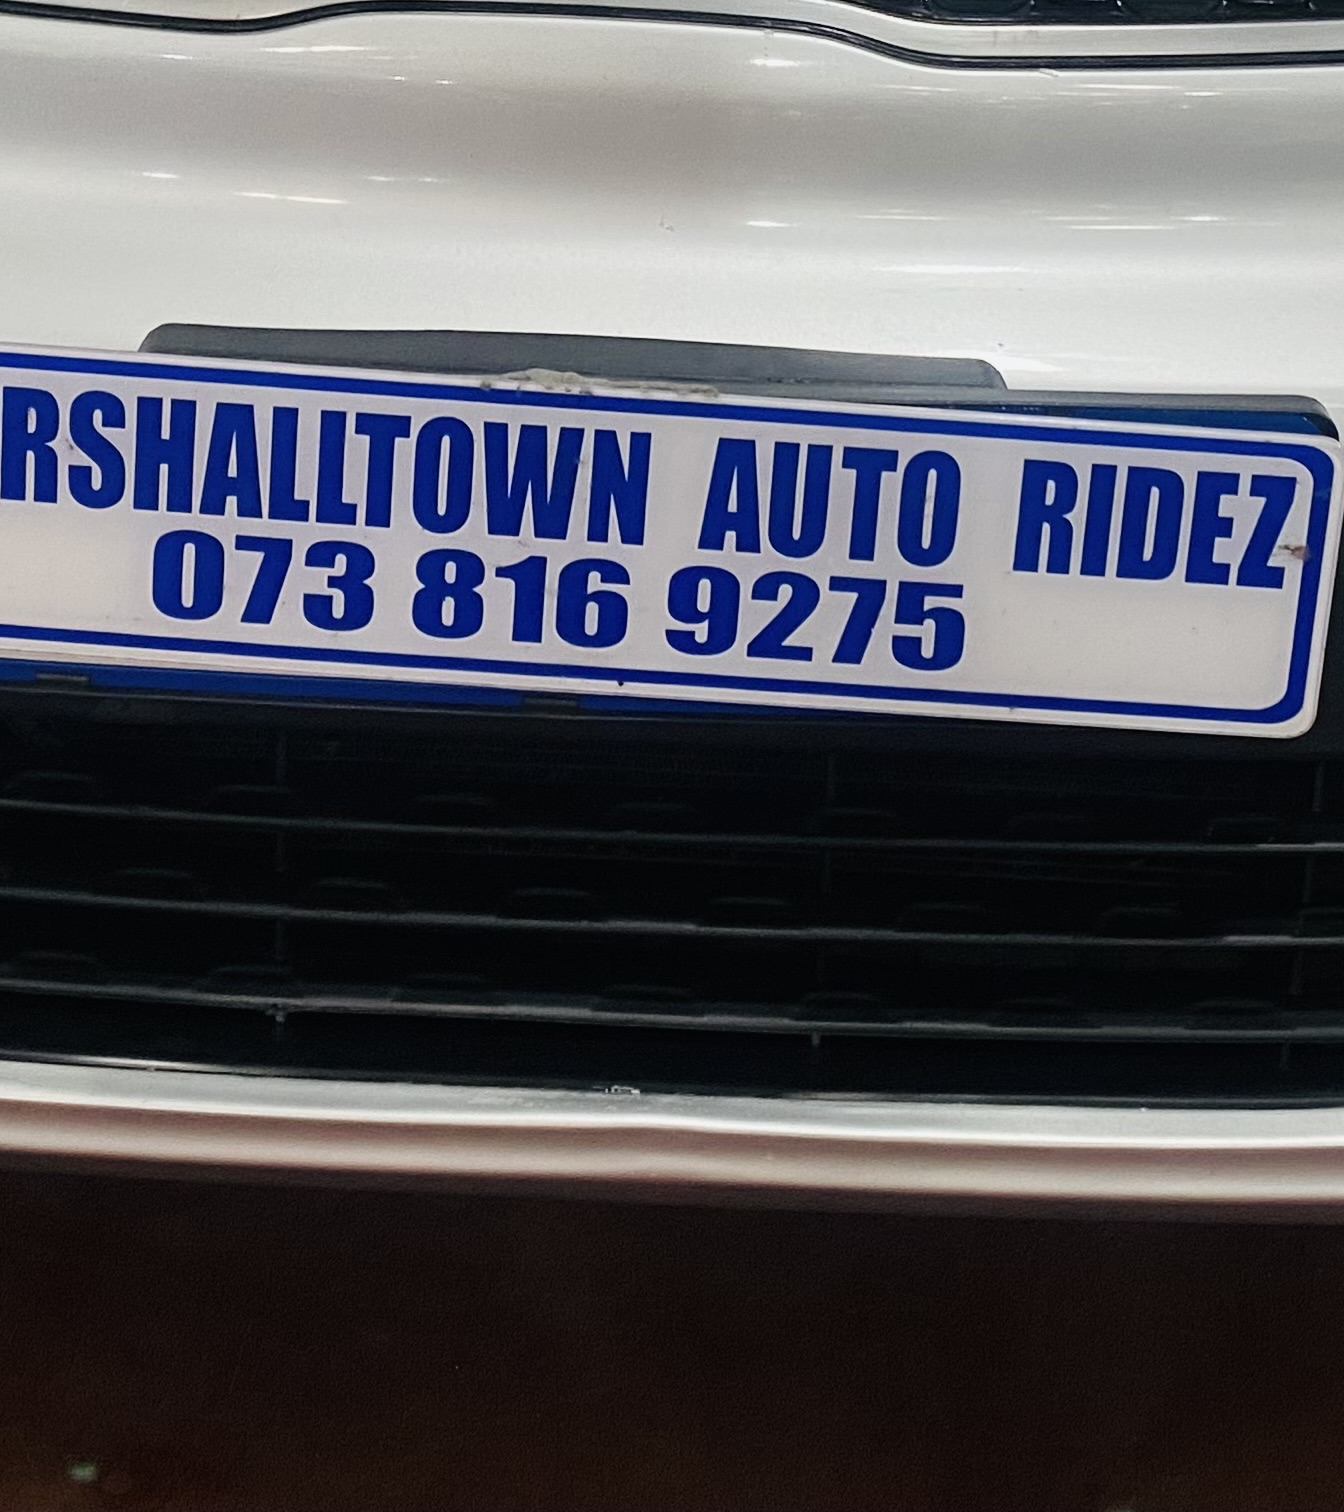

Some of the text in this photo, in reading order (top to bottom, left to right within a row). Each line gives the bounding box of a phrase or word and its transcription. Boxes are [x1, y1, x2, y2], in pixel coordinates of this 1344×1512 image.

[698, 436, 962, 568] AUTO
[1012, 457, 1298, 590] RIDEZ
[152, 528, 966, 672] 073 816 9275
